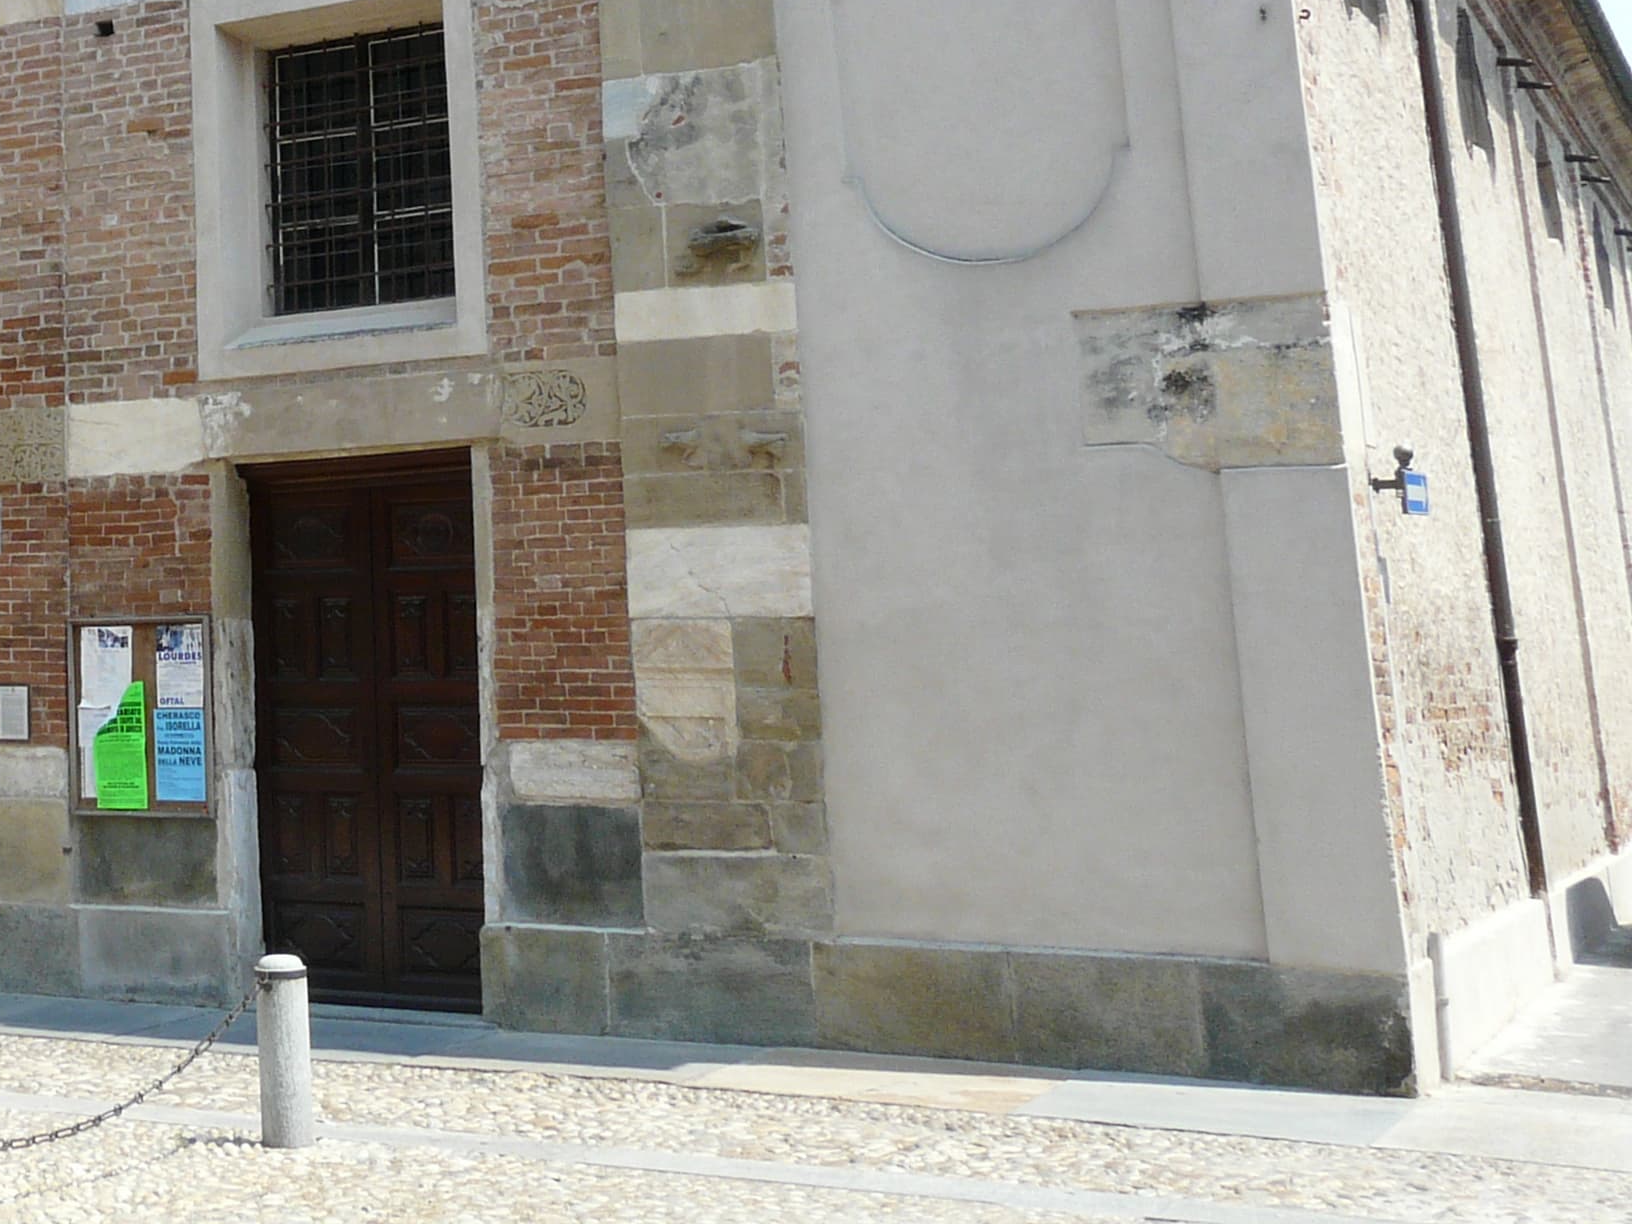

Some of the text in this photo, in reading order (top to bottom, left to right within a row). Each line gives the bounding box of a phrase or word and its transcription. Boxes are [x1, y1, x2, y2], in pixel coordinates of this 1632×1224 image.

[159, 651, 202, 661] LOURDES
[156, 711, 201, 720] CHERASCO
[157, 746, 202, 755] MADONNA
[179, 756, 202, 766] NEVE
